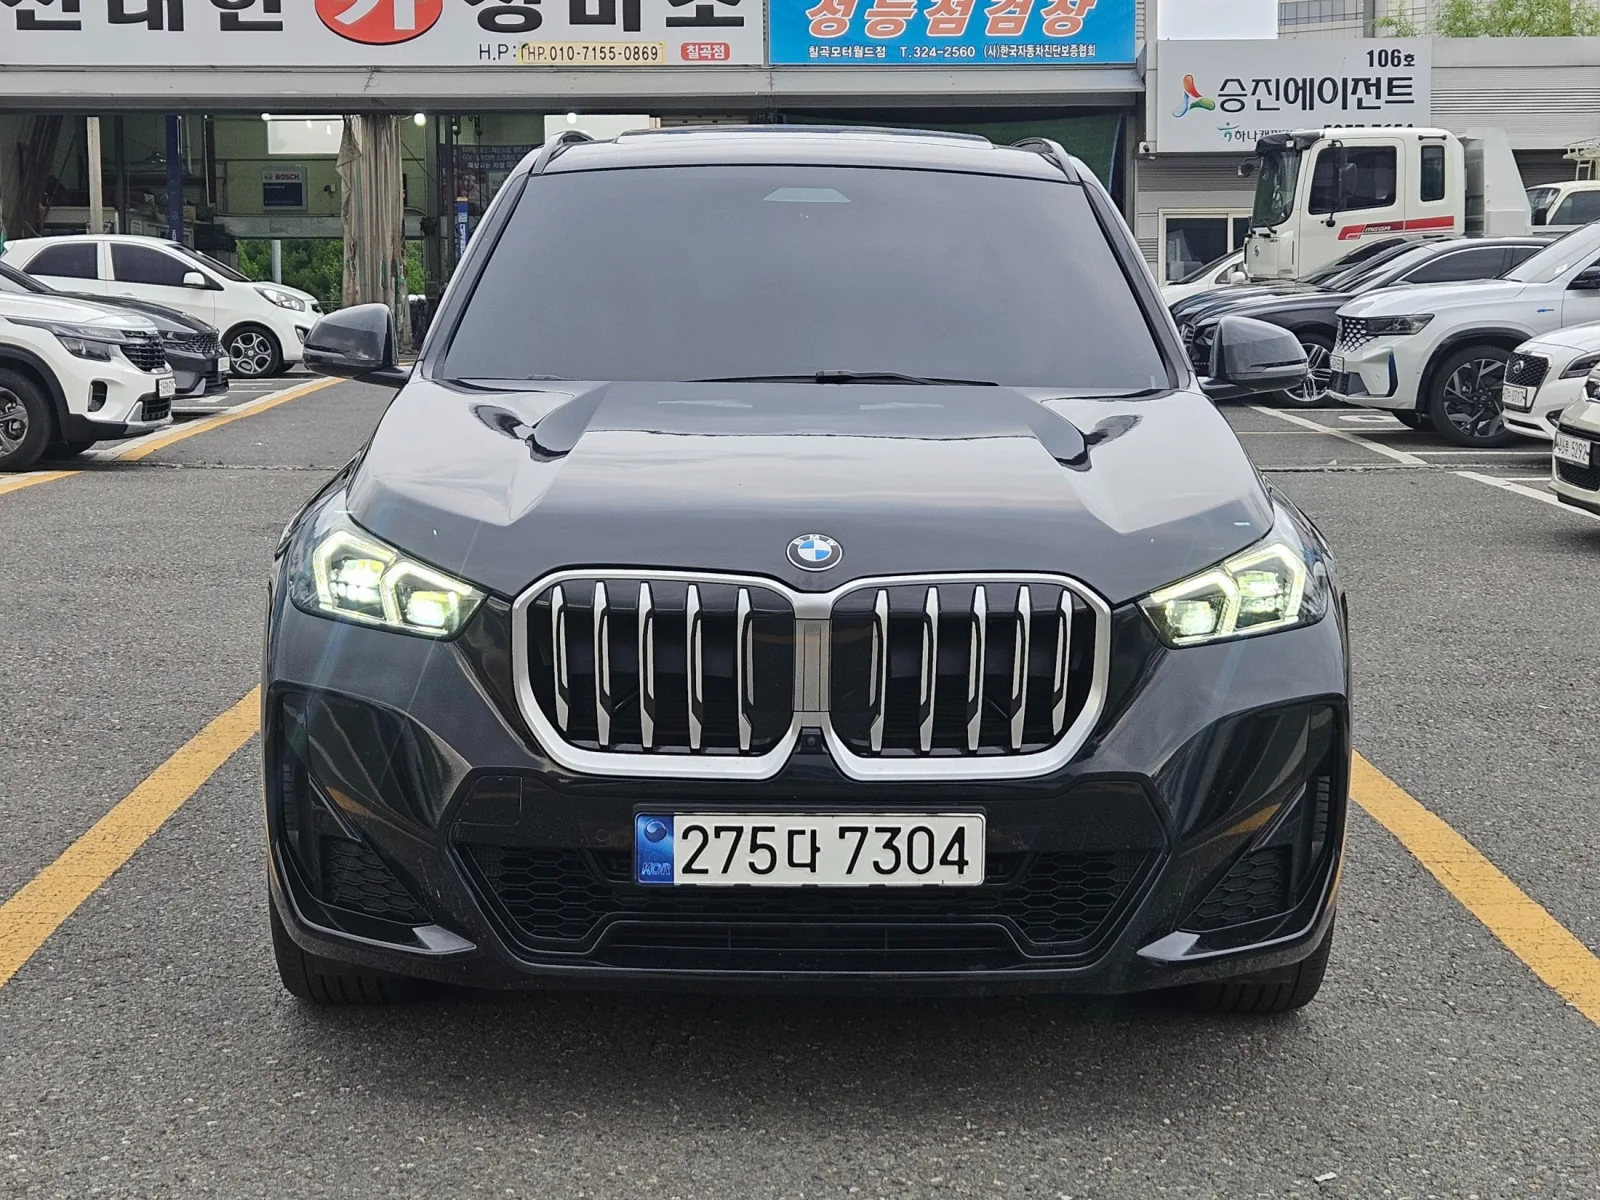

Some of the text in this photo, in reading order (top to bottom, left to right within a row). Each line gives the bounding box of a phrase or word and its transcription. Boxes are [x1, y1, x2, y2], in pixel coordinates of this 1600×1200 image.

[686, 44, 726, 59] 칠곡점
[808, 45, 887, 59] 칠곡모터월드점
[1366, 48, 1416, 67] 106호
[1217, 76, 1415, 112] 승진에이전트
[275, 173, 300, 181] BOSCH
[792, 534, 837, 546] BMW
[682, 825, 969, 875] 275다 7304
[641, 862, 672, 877] KOR
